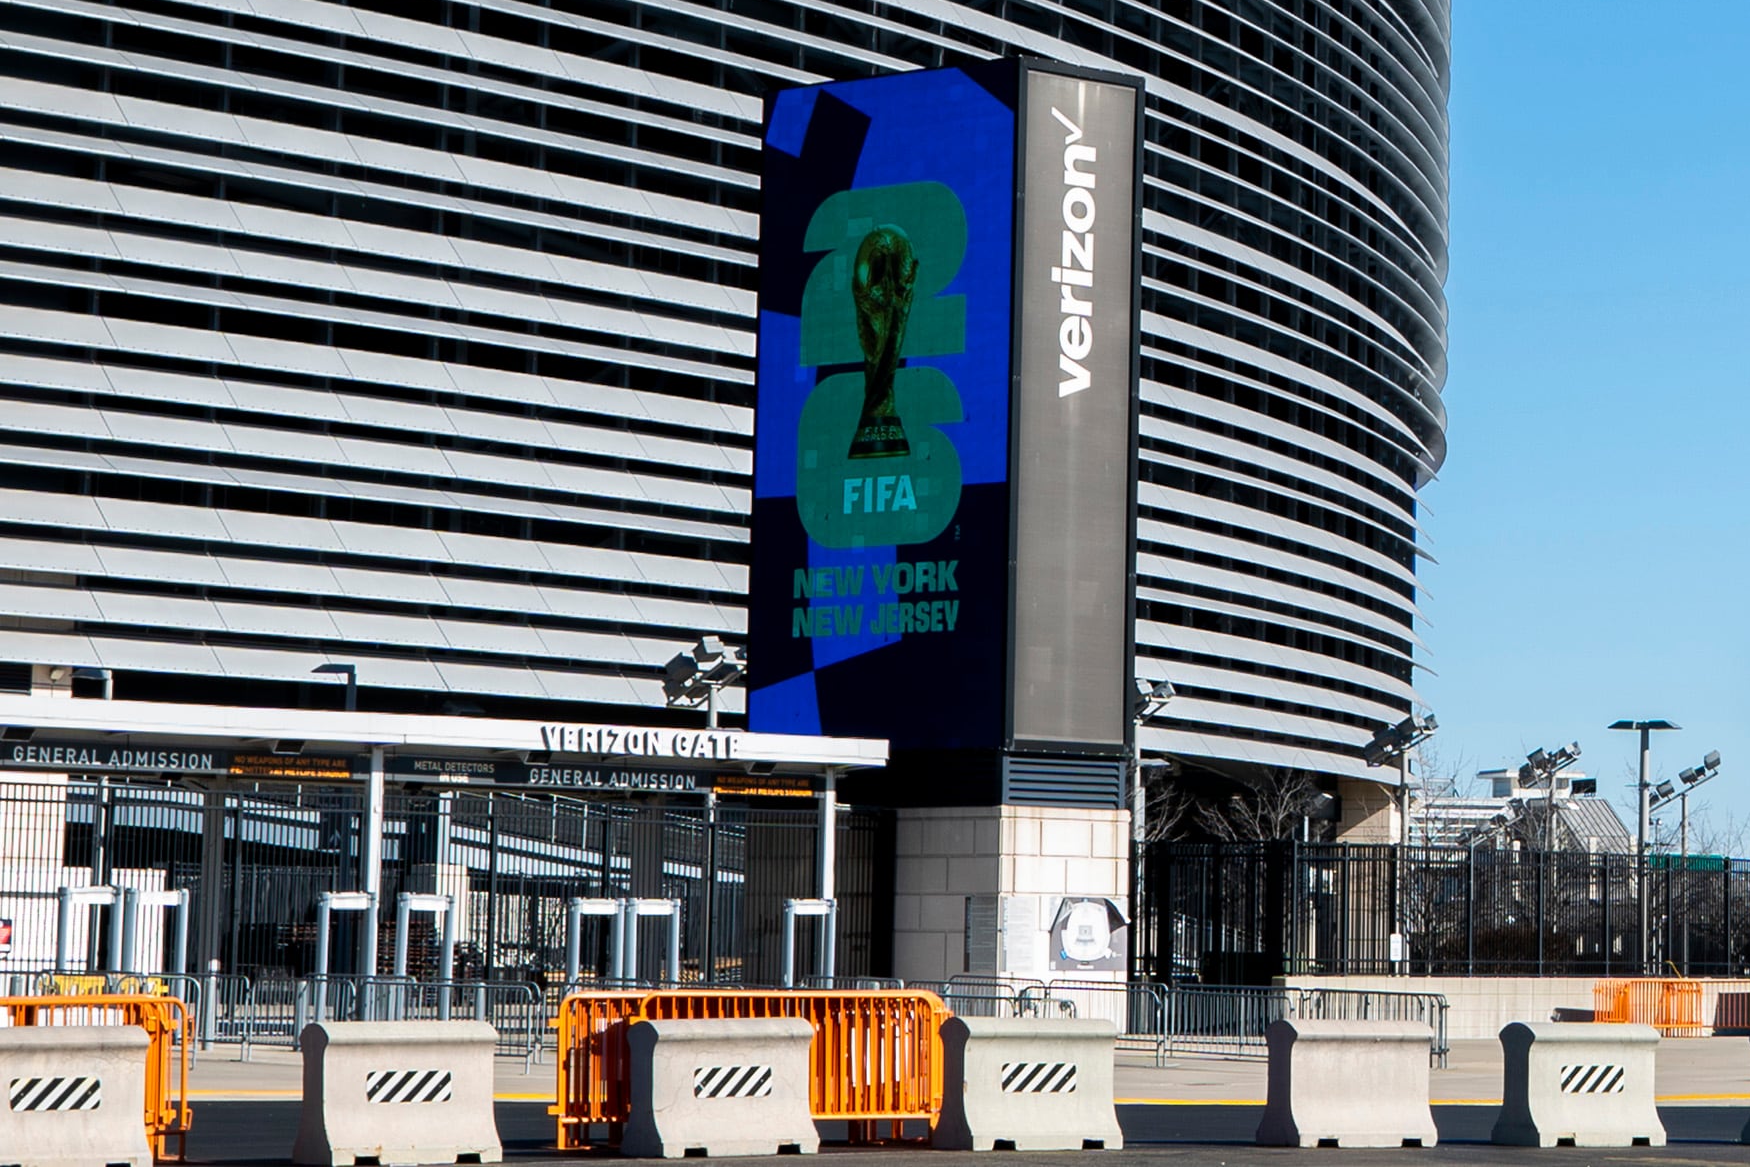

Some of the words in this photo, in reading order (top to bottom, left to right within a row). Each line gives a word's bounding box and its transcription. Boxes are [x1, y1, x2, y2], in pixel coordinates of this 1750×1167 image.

[1051, 145, 1097, 399] verizon
[843, 475, 917, 514] FIFA
[793, 564, 868, 599] NEW
[872, 560, 959, 594] YORK
[792, 603, 867, 638] NEW
[870, 600, 960, 636] JERSEY
[13, 745, 101, 765] GENERAL
[108, 749, 213, 770] ADMISSION
[540, 725, 659, 756] VERIZON
[671, 732, 743, 759] GATE
[414, 760, 443, 771] METAL
[445, 761, 495, 773] DETECTORS
[529, 768, 602, 785] GENERAL
[608, 772, 696, 790] ADMISSION
